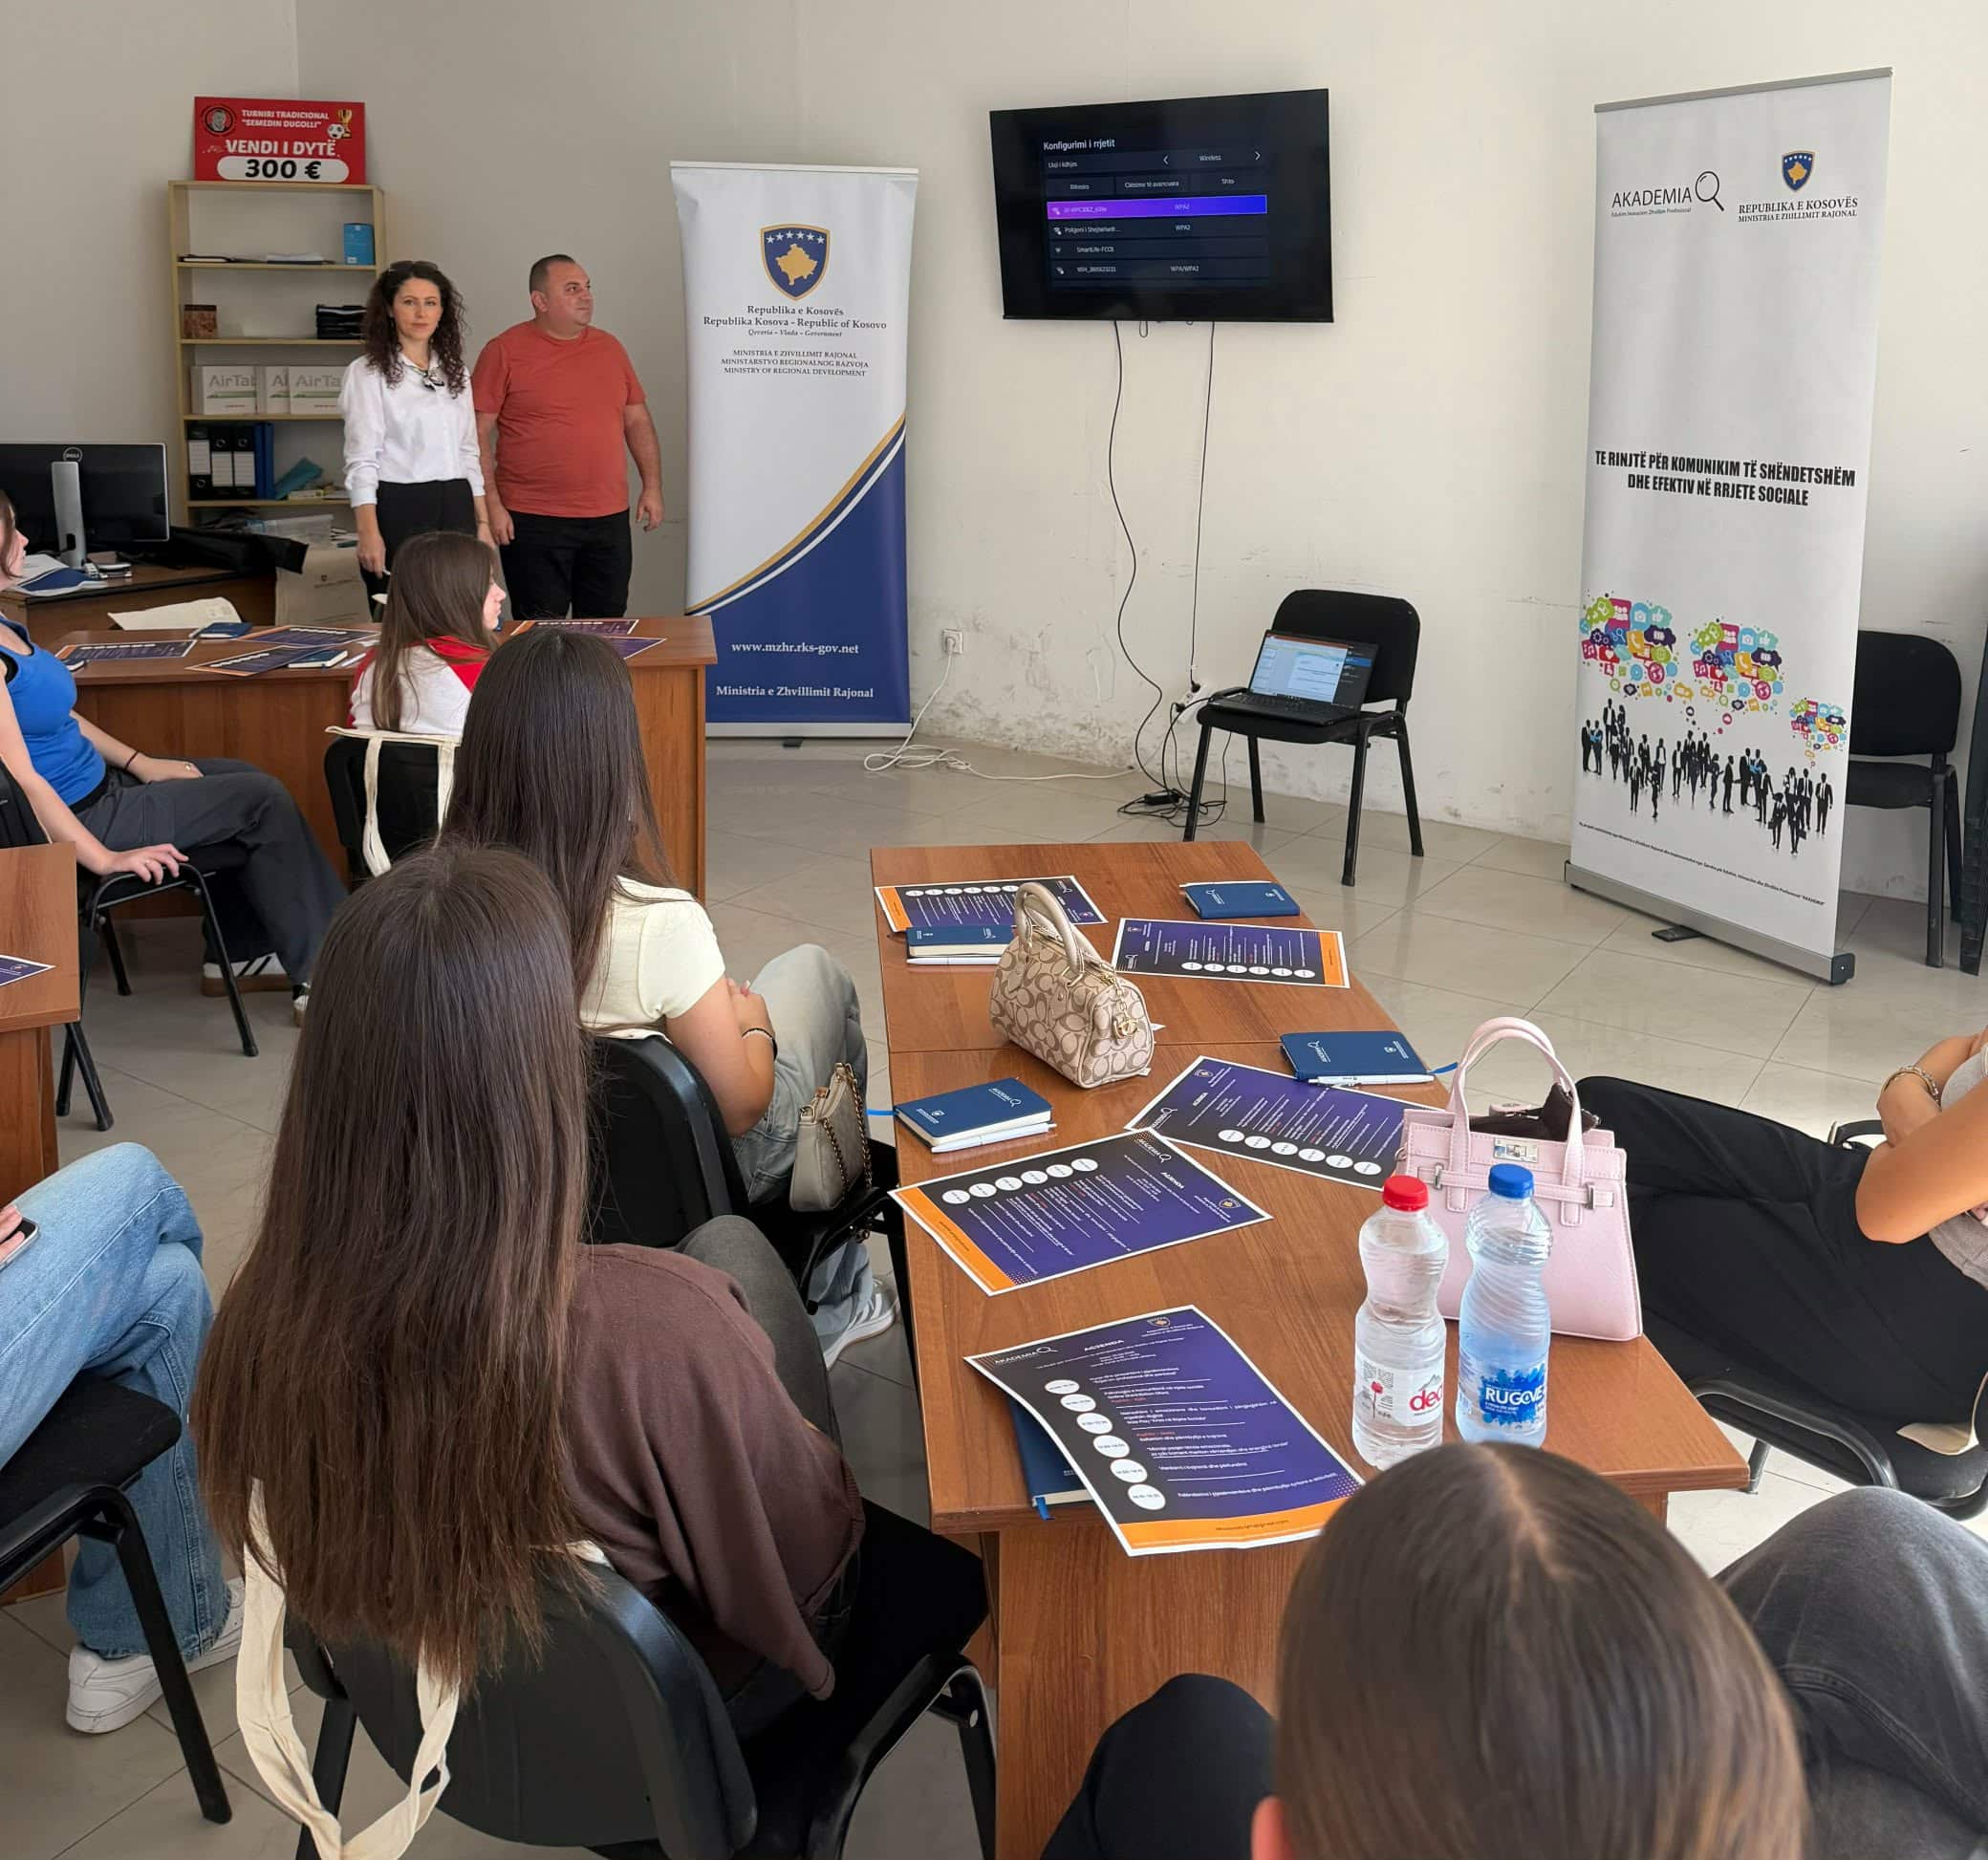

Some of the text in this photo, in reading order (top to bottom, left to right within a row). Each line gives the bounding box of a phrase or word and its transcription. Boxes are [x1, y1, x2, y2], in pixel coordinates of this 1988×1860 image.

[241, 109, 329, 119] TURNIRI TRADICIONAL
[226, 139, 336, 156] VENDI I DYTË
[1044, 140, 1087, 151] Konfigurimi
[1093, 138, 1115, 149] rrjetit
[245, 159, 322, 180] 300 €
[1611, 187, 1692, 208] AKADEMIA
[1740, 196, 1858, 214] REPUBLIKA E KOSOVËS
[1822, 209, 1857, 218] RAJONAL
[747, 306, 795, 315] Republika
[807, 306, 844, 315] Kosovës
[703, 316, 752, 327] Republika
[755, 317, 789, 326] Kosova
[797, 317, 839, 329] Republic
[841, 319, 851, 328] of
[853, 320, 887, 329] Kosovo
[1595, 449, 1856, 487] TE RINJTË PËR KOMUNIKIM TË SHËNDETSHËM
[1628, 473, 1808, 506] DHE EFEKTIV NË RRJETE SOCIALE
[731, 642, 858, 655] www.mzhr.rks-gov.net
[716, 685, 765, 696] Ministria
[776, 686, 831, 697] Zhvillimit
[833, 687, 874, 700] Rajonal
